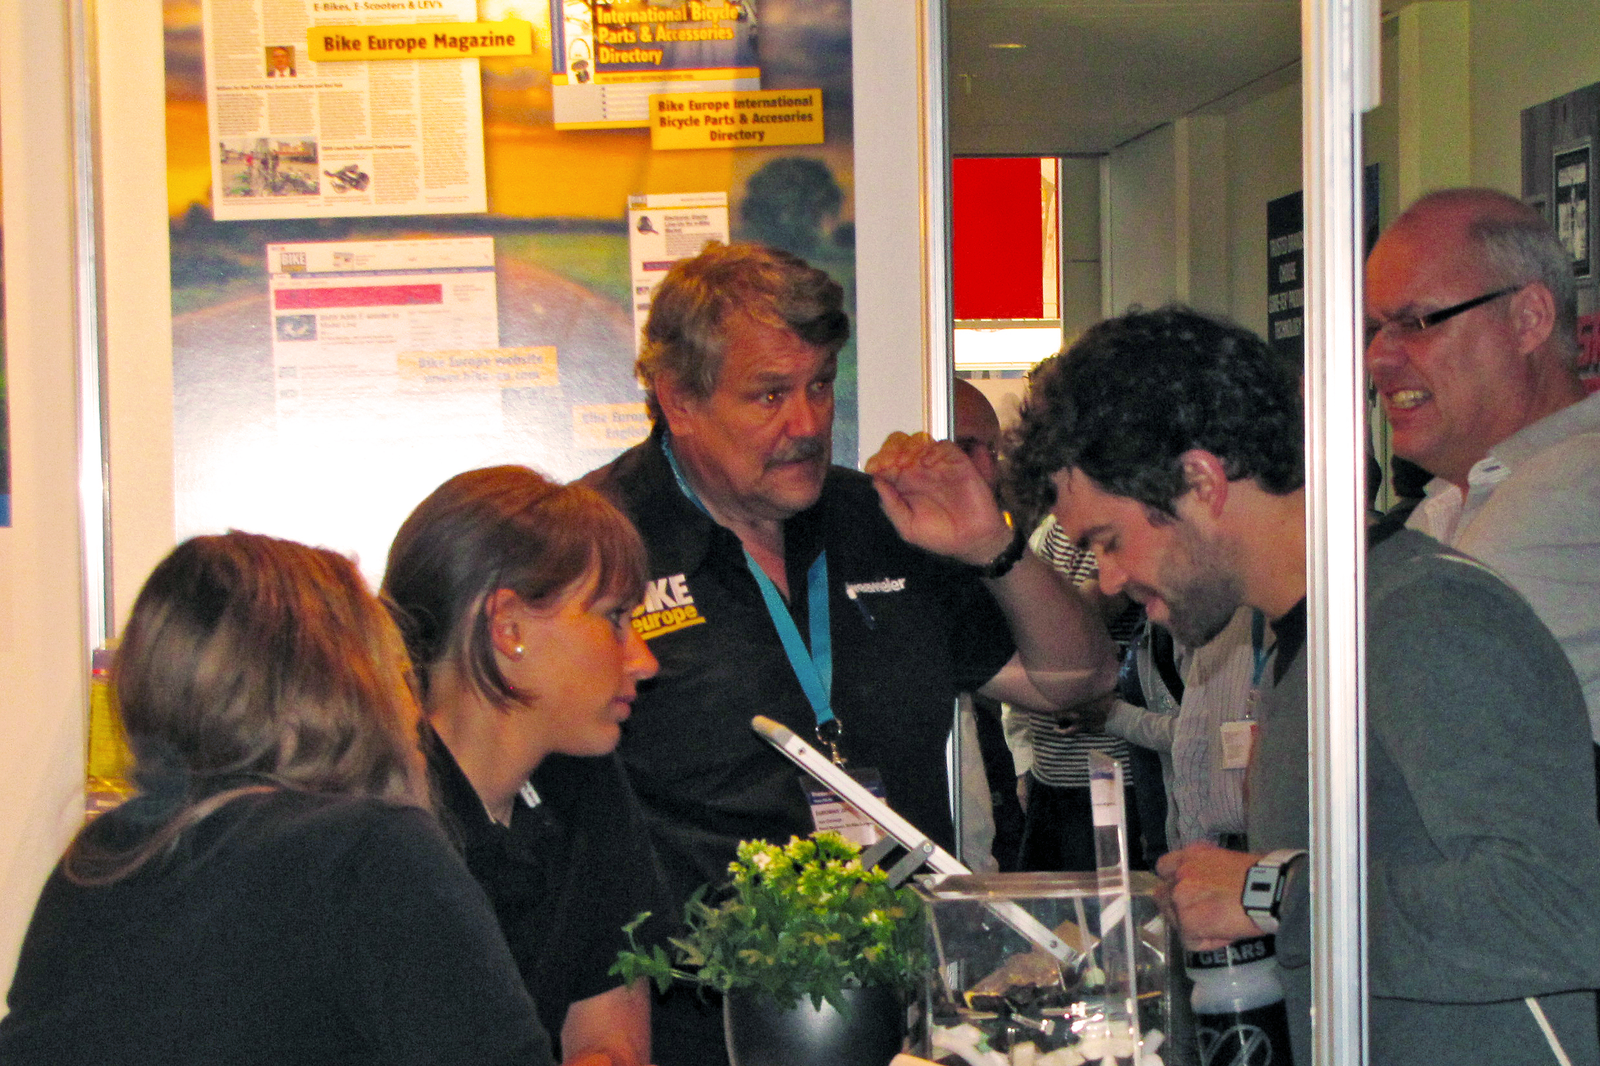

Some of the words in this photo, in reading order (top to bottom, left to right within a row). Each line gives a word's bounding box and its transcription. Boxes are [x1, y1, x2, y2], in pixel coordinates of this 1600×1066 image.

[314, 2, 351, 12] E-Bikes,
[355, 0, 405, 10] E-Scooters
[408, 1, 414, 9] &
[596, 3, 688, 24] International
[690, 0, 740, 28] Bicycle
[323, 34, 362, 51] Bike
[368, 34, 427, 53] Europe
[433, 30, 516, 52] Magazine
[597, 24, 637, 44] Parts
[639, 23, 653, 42] &
[655, 23, 735, 42] Accessories
[598, 44, 664, 65] Directory
[657, 100, 684, 112] Bike
[689, 99, 730, 114] Europe
[733, 95, 813, 110] International
[659, 115, 700, 129] Bicycle
[704, 114, 735, 126] Parts
[739, 113, 748, 124] &
[752, 110, 813, 124] Accesories
[709, 128, 765, 141] Directory
[281, 252, 307, 267] BIKE
[644, 573, 694, 613] IKE
[631, 604, 698, 633] europe
